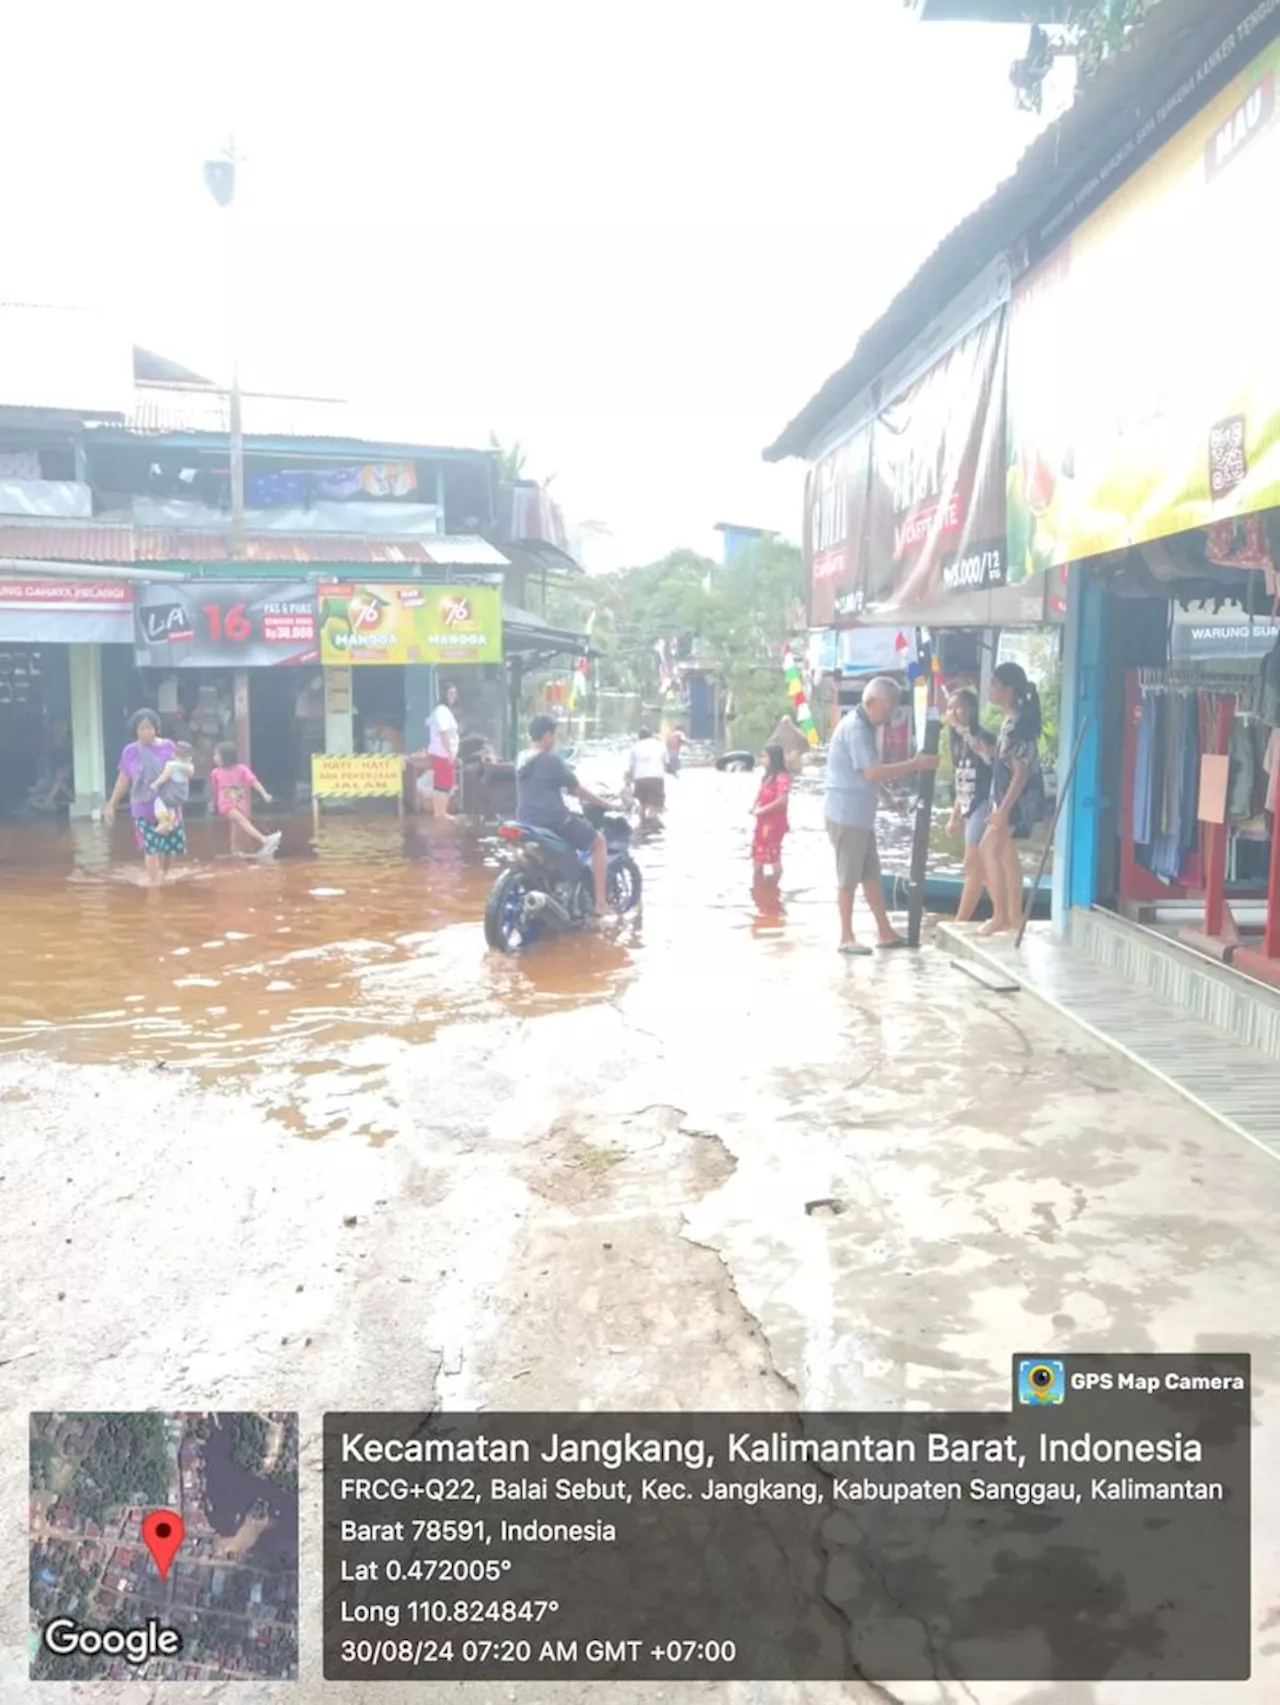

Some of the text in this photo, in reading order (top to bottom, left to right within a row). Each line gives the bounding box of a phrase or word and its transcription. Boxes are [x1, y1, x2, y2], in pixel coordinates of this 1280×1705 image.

[1196, 33, 1236, 84] KANKER
[149, 608, 184, 633] LA
[204, 604, 251, 641] 16
[335, 633, 397, 645] MANGGA
[428, 634, 487, 645] MANGGA
[1191, 627, 1249, 640] WARUNG
